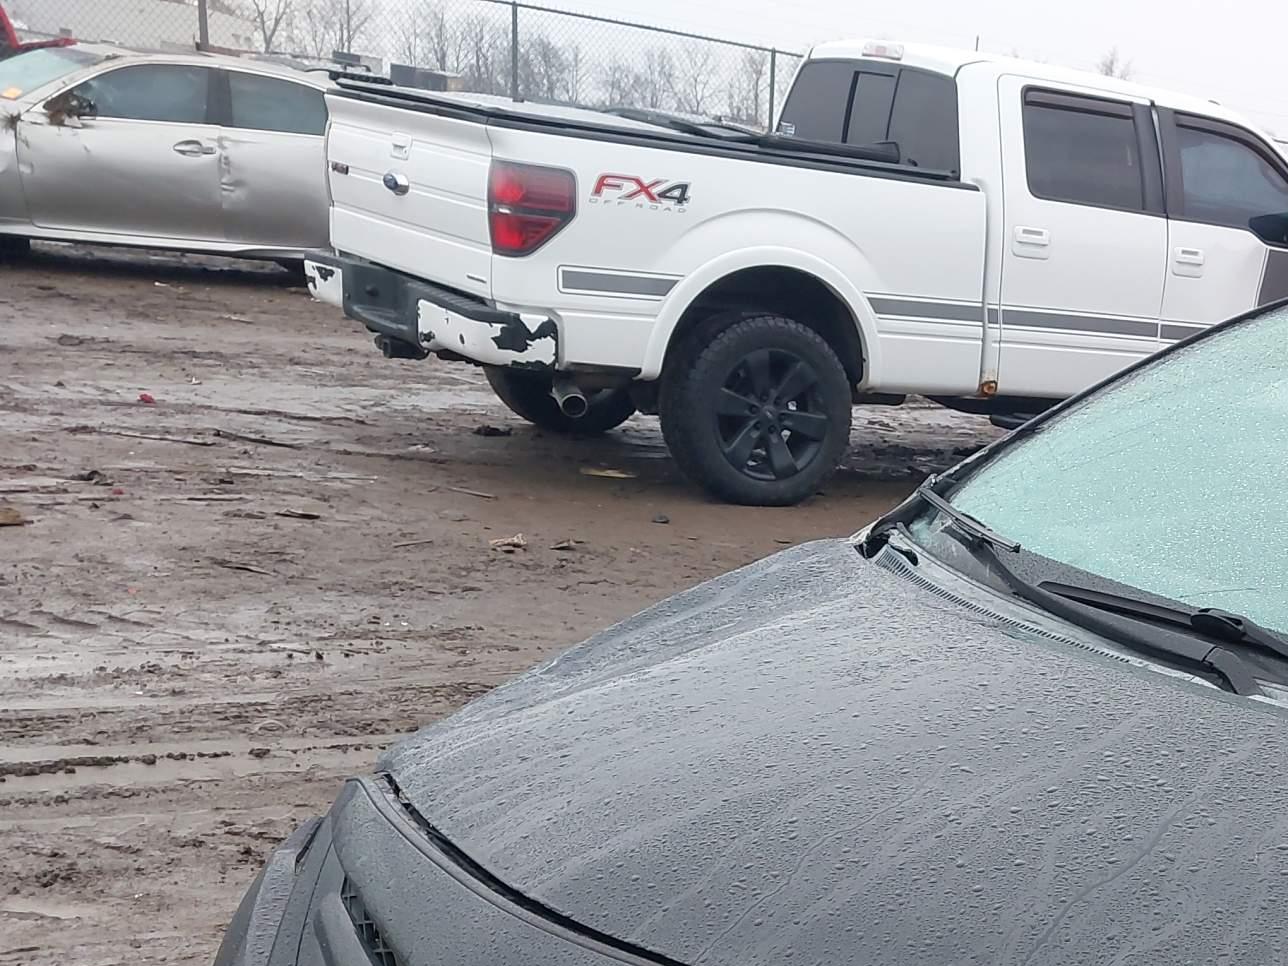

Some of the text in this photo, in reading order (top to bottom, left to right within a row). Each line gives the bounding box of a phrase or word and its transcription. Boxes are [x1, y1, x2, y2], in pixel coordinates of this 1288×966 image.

[591, 173, 691, 205] FX4
[589, 198, 687, 213] OFF ROAD
